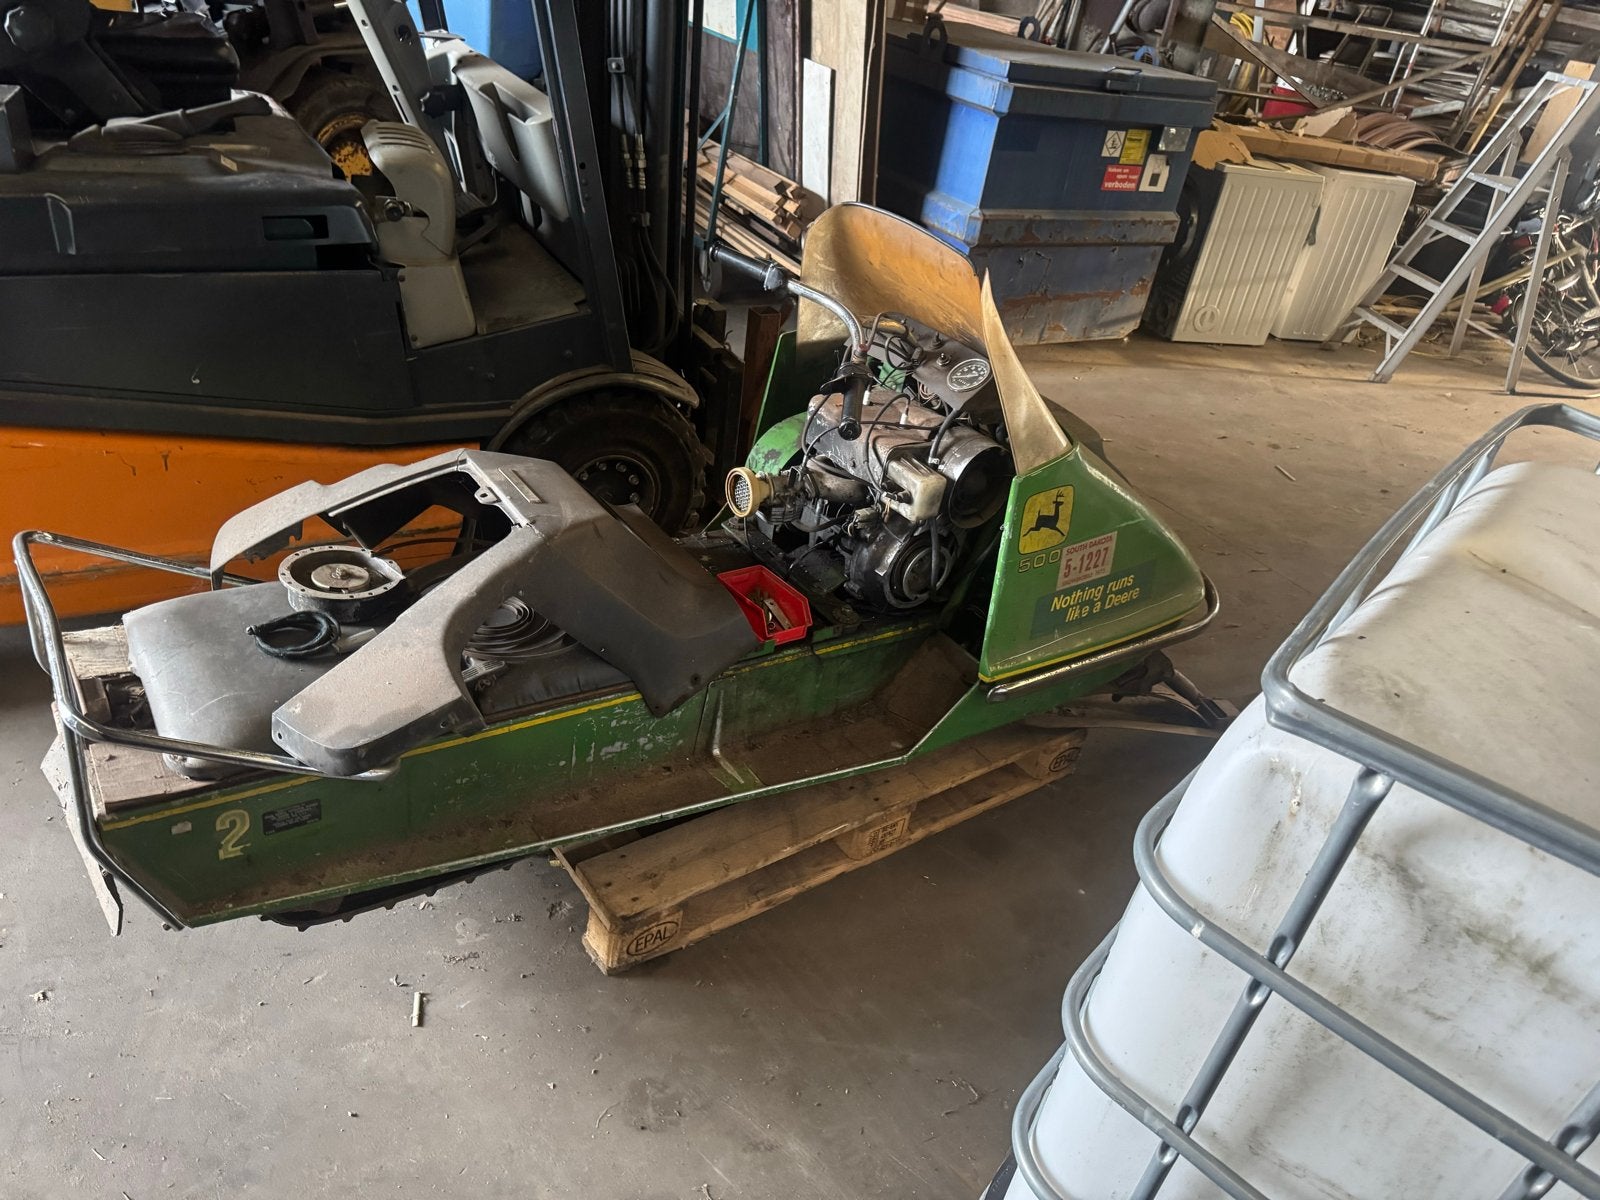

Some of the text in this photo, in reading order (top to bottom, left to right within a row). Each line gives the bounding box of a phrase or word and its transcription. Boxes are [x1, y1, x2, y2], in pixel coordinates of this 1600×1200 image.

[1104, 181, 1136, 189] verboden
[1019, 549, 1061, 573] 500
[1063, 547, 1109, 578] 5-1227
[1065, 543, 1088, 555] SOUTH
[1050, 584, 1104, 612] Nothing
[1106, 574, 1135, 593] runs
[1065, 587, 1140, 623] like a Deere
[215, 809, 251, 860] 2
[635, 926, 671, 953] EPAL
